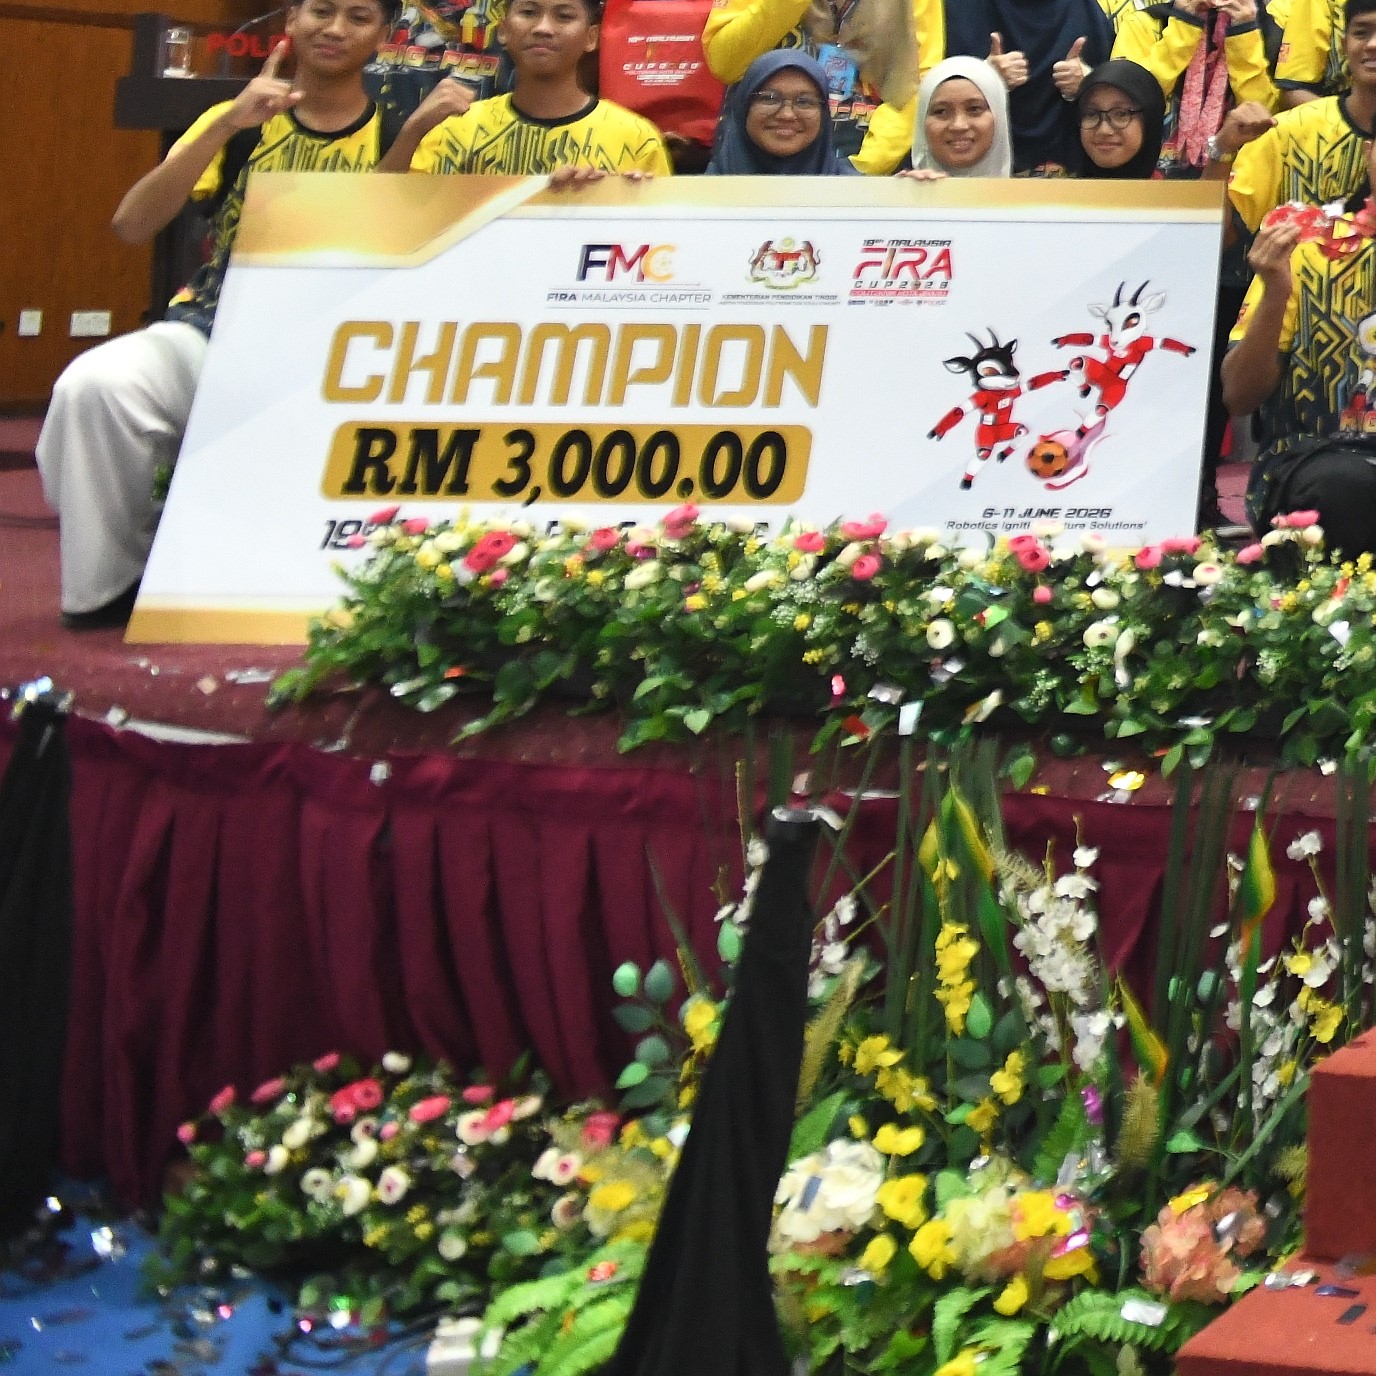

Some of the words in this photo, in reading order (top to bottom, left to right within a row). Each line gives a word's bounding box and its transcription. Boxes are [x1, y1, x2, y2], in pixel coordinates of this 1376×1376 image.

[887, 239, 952, 247] MALAYSIA
[576, 244, 677, 283] FMC
[853, 247, 953, 280] FIRA
[546, 293, 578, 302] FIRA
[581, 293, 647, 303] MALAYSIA
[649, 293, 712, 303] CHAPTER
[320, 320, 829, 409] CHAMPION
[340, 427, 481, 497] RM
[490, 428, 788, 509] 3,000.00
[982, 507, 1014, 519] 6-11
[1017, 507, 1061, 519] JUNE
[1064, 508, 1113, 519] 2026
